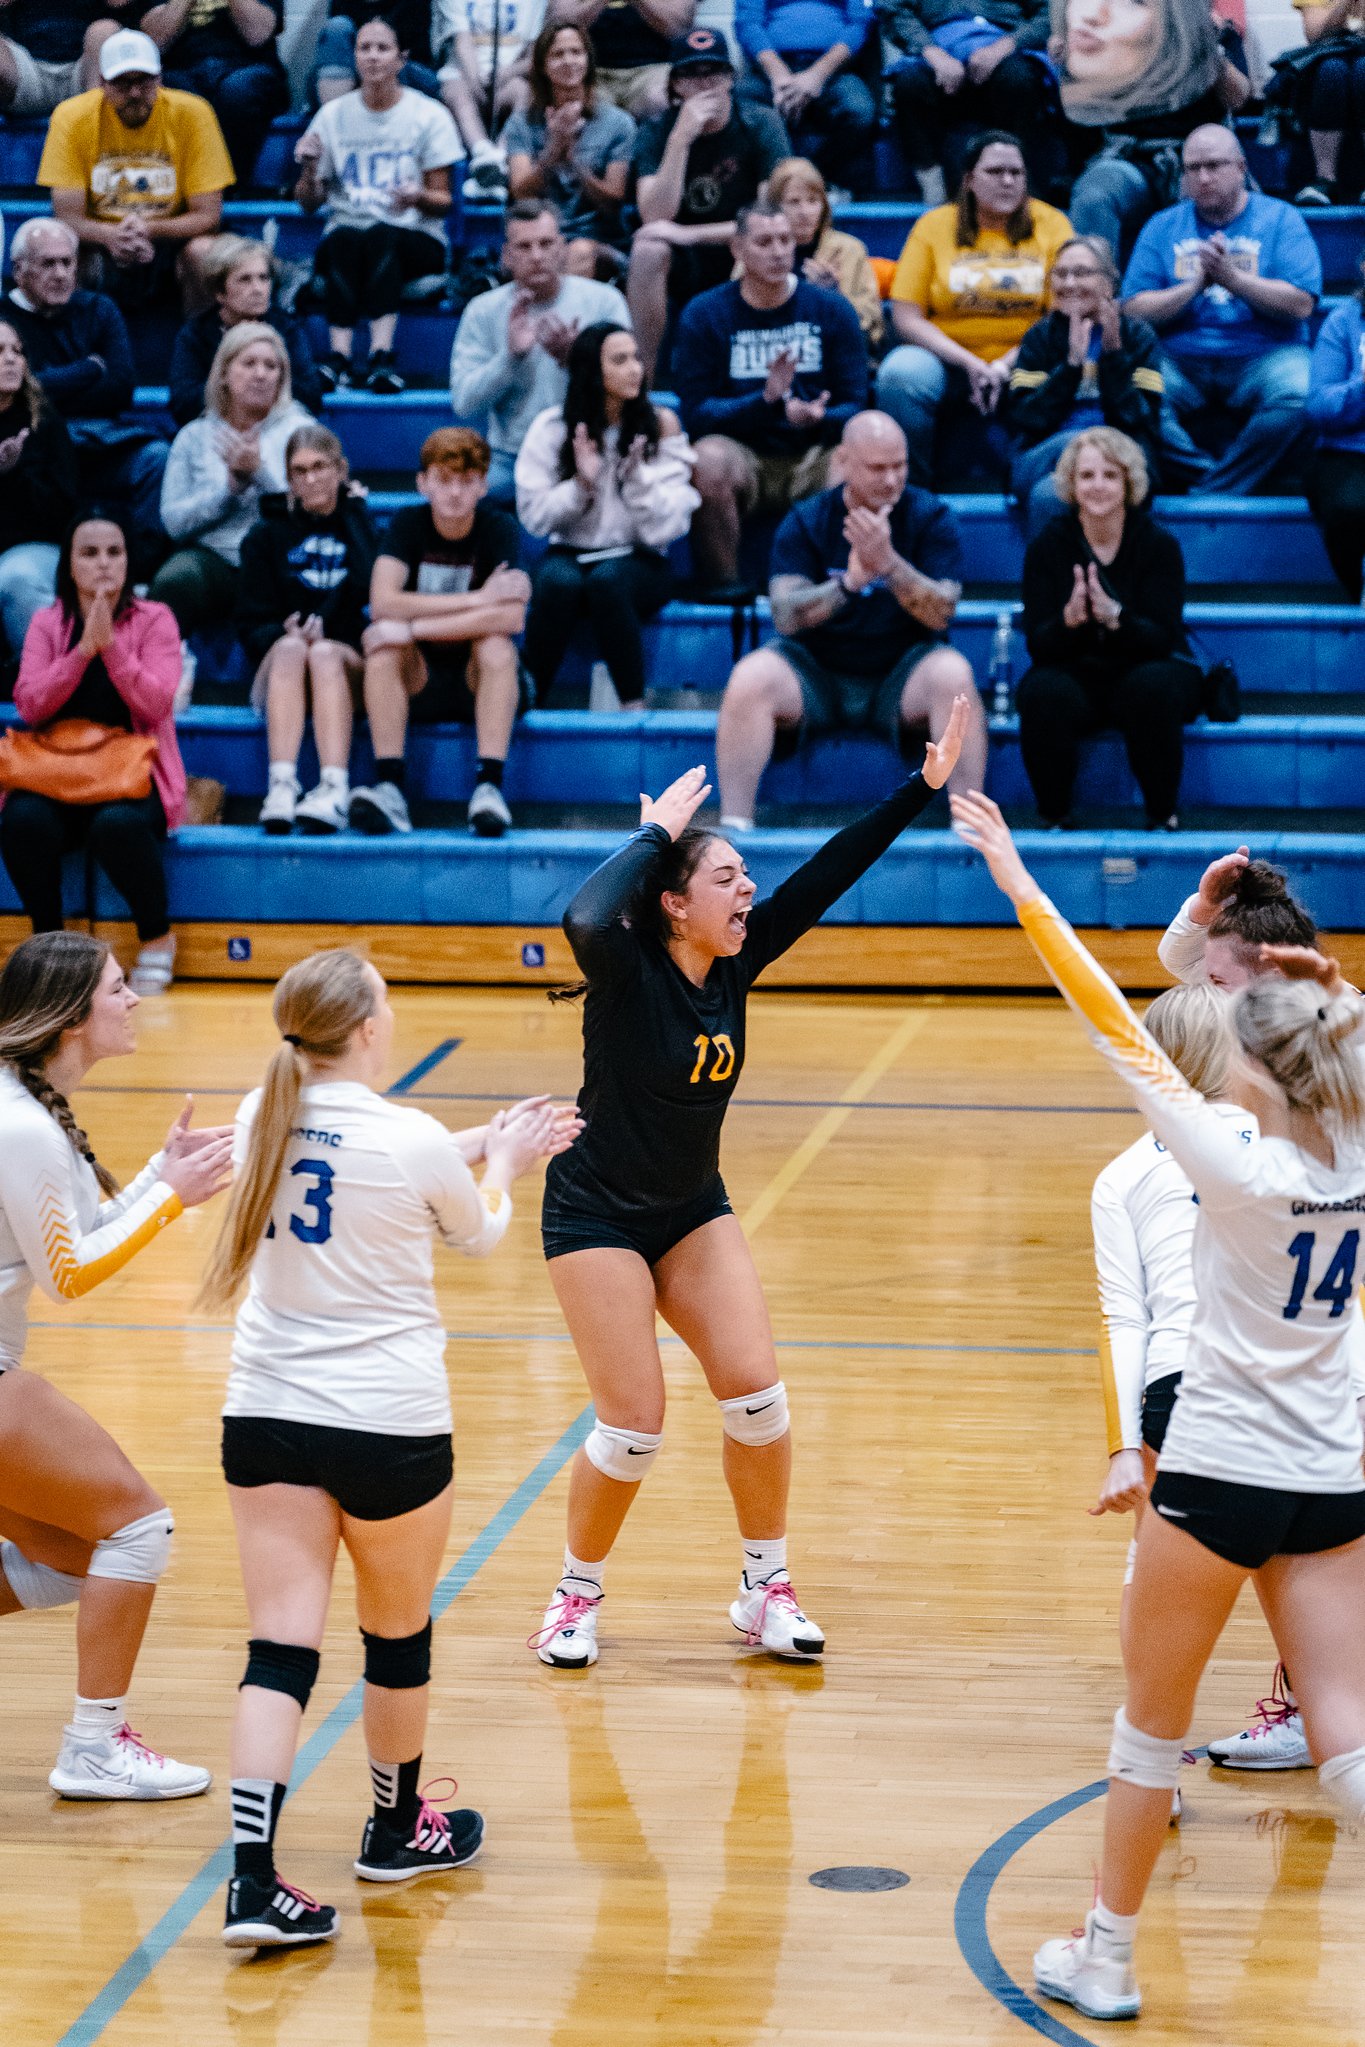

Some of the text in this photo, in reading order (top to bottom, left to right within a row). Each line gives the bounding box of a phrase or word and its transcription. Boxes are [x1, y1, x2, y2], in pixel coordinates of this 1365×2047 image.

[690, 1033, 735, 1084] 10
[266, 1158, 335, 1245] 3
[1283, 1228, 1359, 1319] 14
